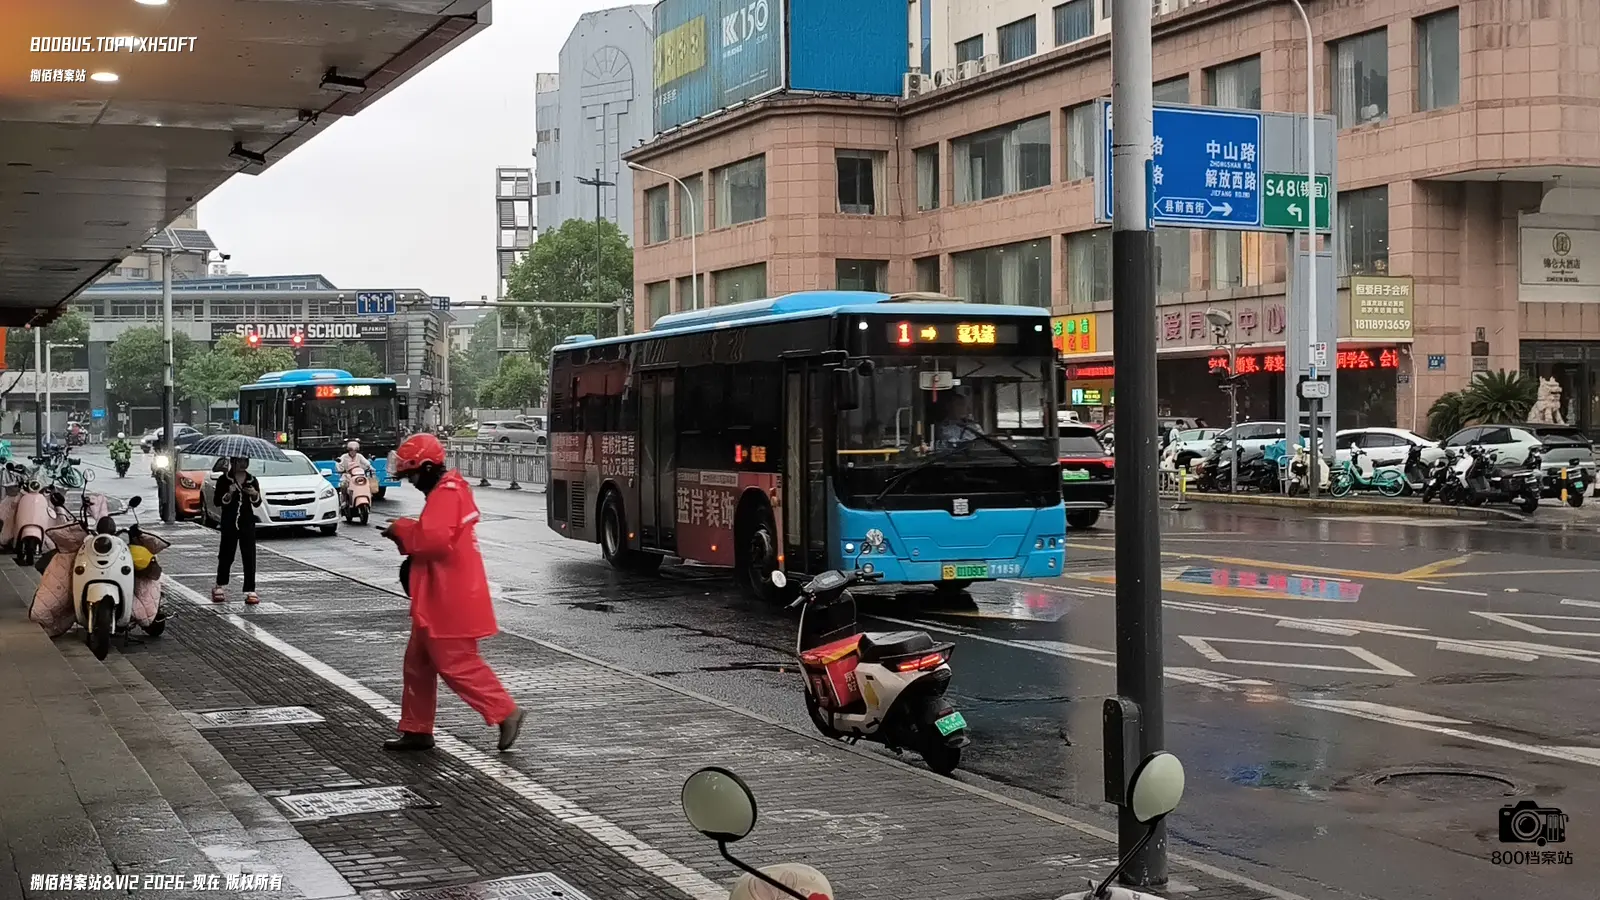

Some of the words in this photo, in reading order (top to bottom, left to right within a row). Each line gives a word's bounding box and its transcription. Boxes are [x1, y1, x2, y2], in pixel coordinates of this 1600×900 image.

[1206, 139, 1256, 163] 中山路
[1205, 168, 1256, 191] 解放西路
[1165, 200, 1204, 214] 县前西街
[1356, 284, 1409, 296] 恒爱月子会所
[235, 323, 253, 338] SG
[256, 323, 304, 338] DANCE
[307, 323, 361, 338] SCHOOL
[1156, 304, 1286, 341] 爱月中心
[1355, 319, 1410, 330] 18118913659
[898, 323, 910, 343] 1
[677, 487, 735, 529] 蓝岸装饰
